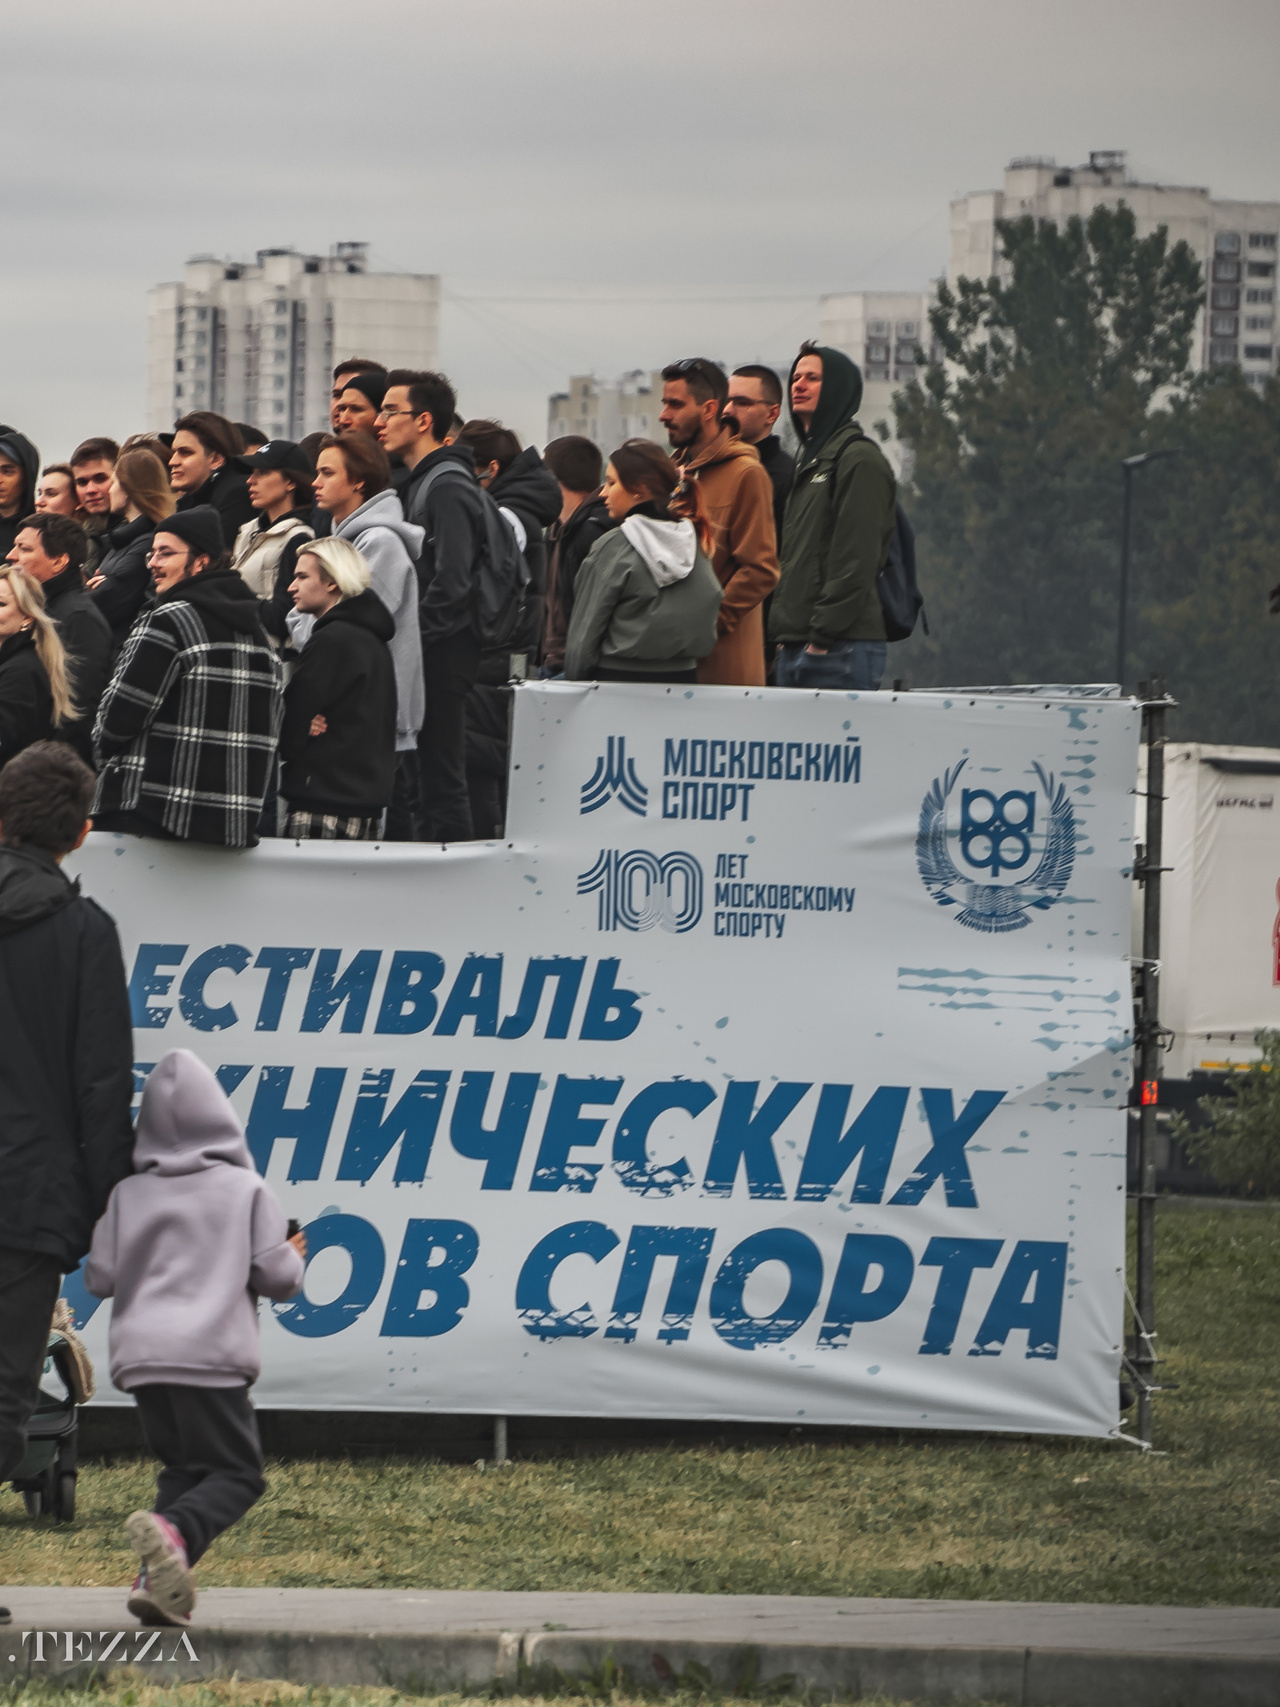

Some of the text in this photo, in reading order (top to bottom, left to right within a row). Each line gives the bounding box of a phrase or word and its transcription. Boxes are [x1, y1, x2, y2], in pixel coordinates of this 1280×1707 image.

[664, 736, 862, 784] МОСКОВСКИЙ
[662, 781, 755, 822] СПОРТ
[714, 853, 749, 879] ЛЕТ
[576, 849, 704, 934] 100
[714, 882, 856, 913] МОСКОВСКОМУ
[714, 911, 785, 938] СПОРТУ
[127, 943, 644, 1042] ЕСТИВАЛЬ
[129, 1062, 1009, 1209] НИЧЕСКИХ
[514, 1219, 1070, 1361] СПОРТА
